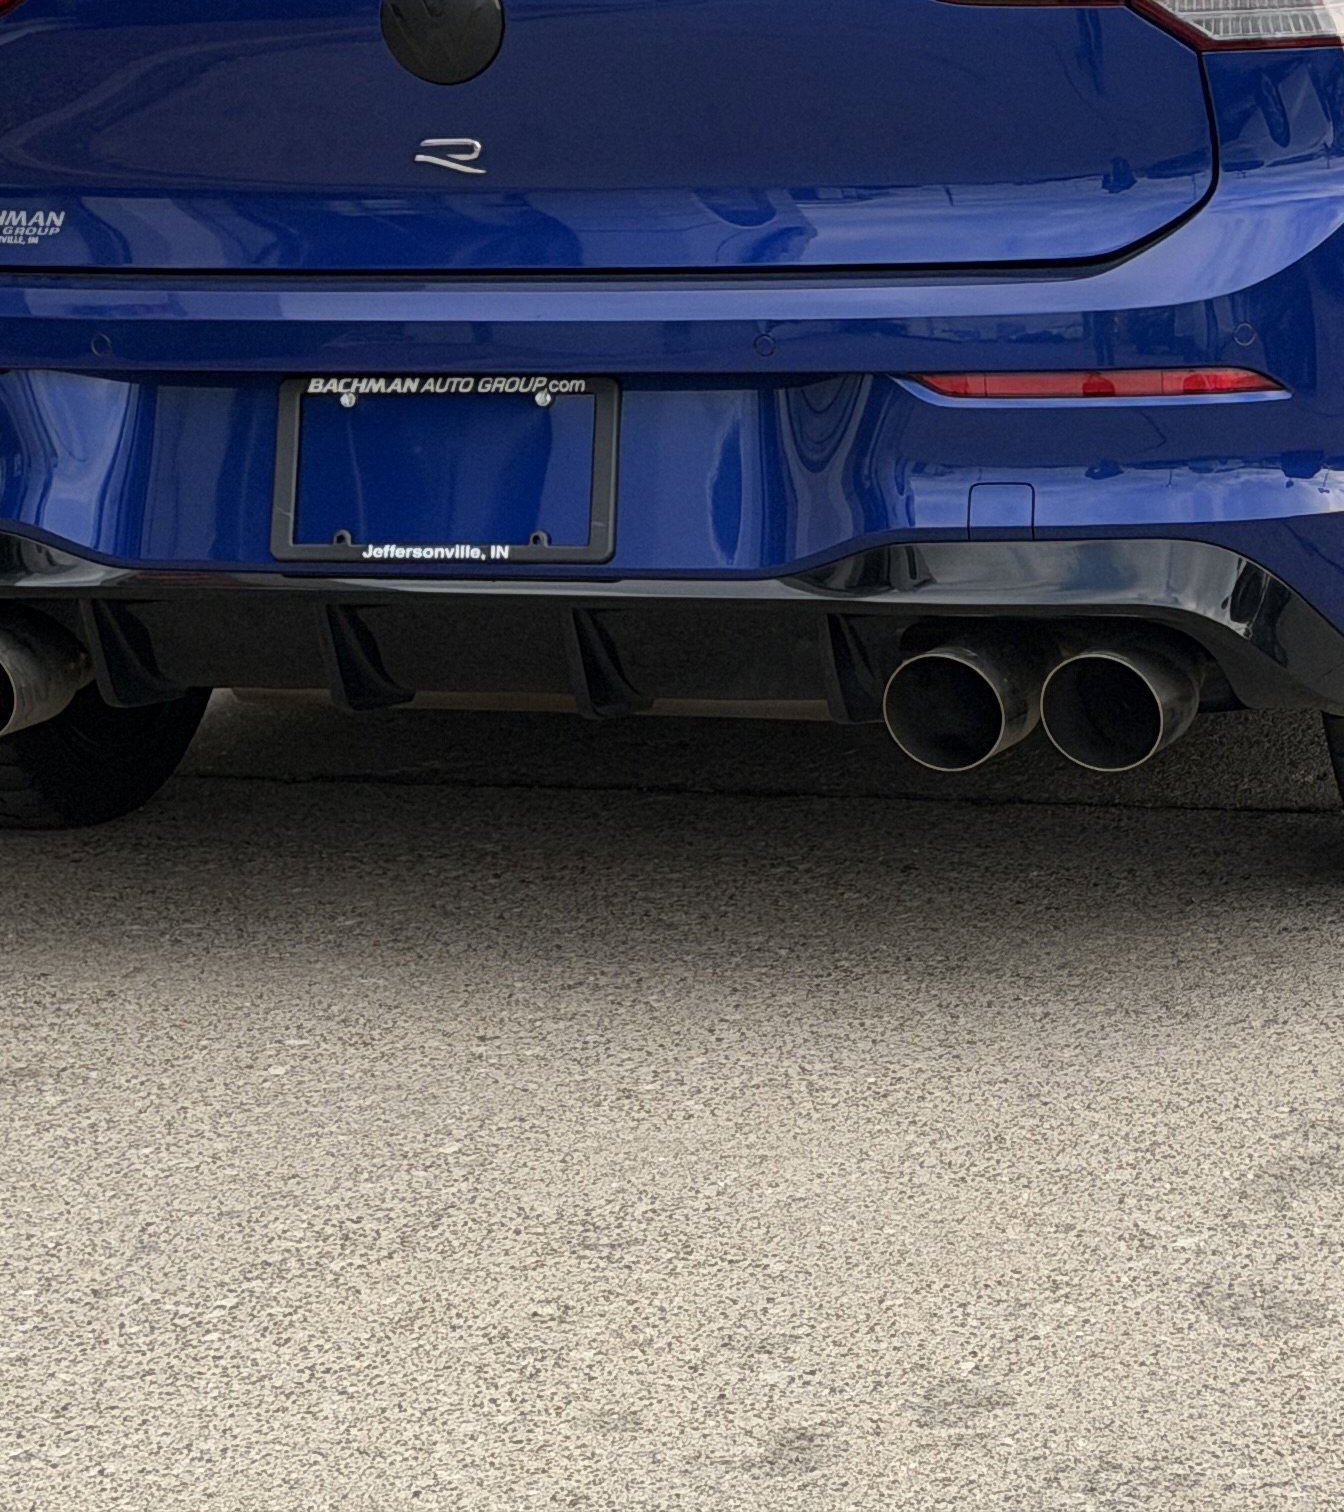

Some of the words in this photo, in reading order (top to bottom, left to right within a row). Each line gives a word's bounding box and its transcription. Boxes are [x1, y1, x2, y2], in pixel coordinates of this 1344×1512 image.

[3, 226, 61, 236] GROUP
[307, 377, 420, 393] BACHMAN
[420, 377, 474, 393] AUTO
[362, 544, 486, 561] Jeffersonville,
[490, 545, 510, 559] IN
